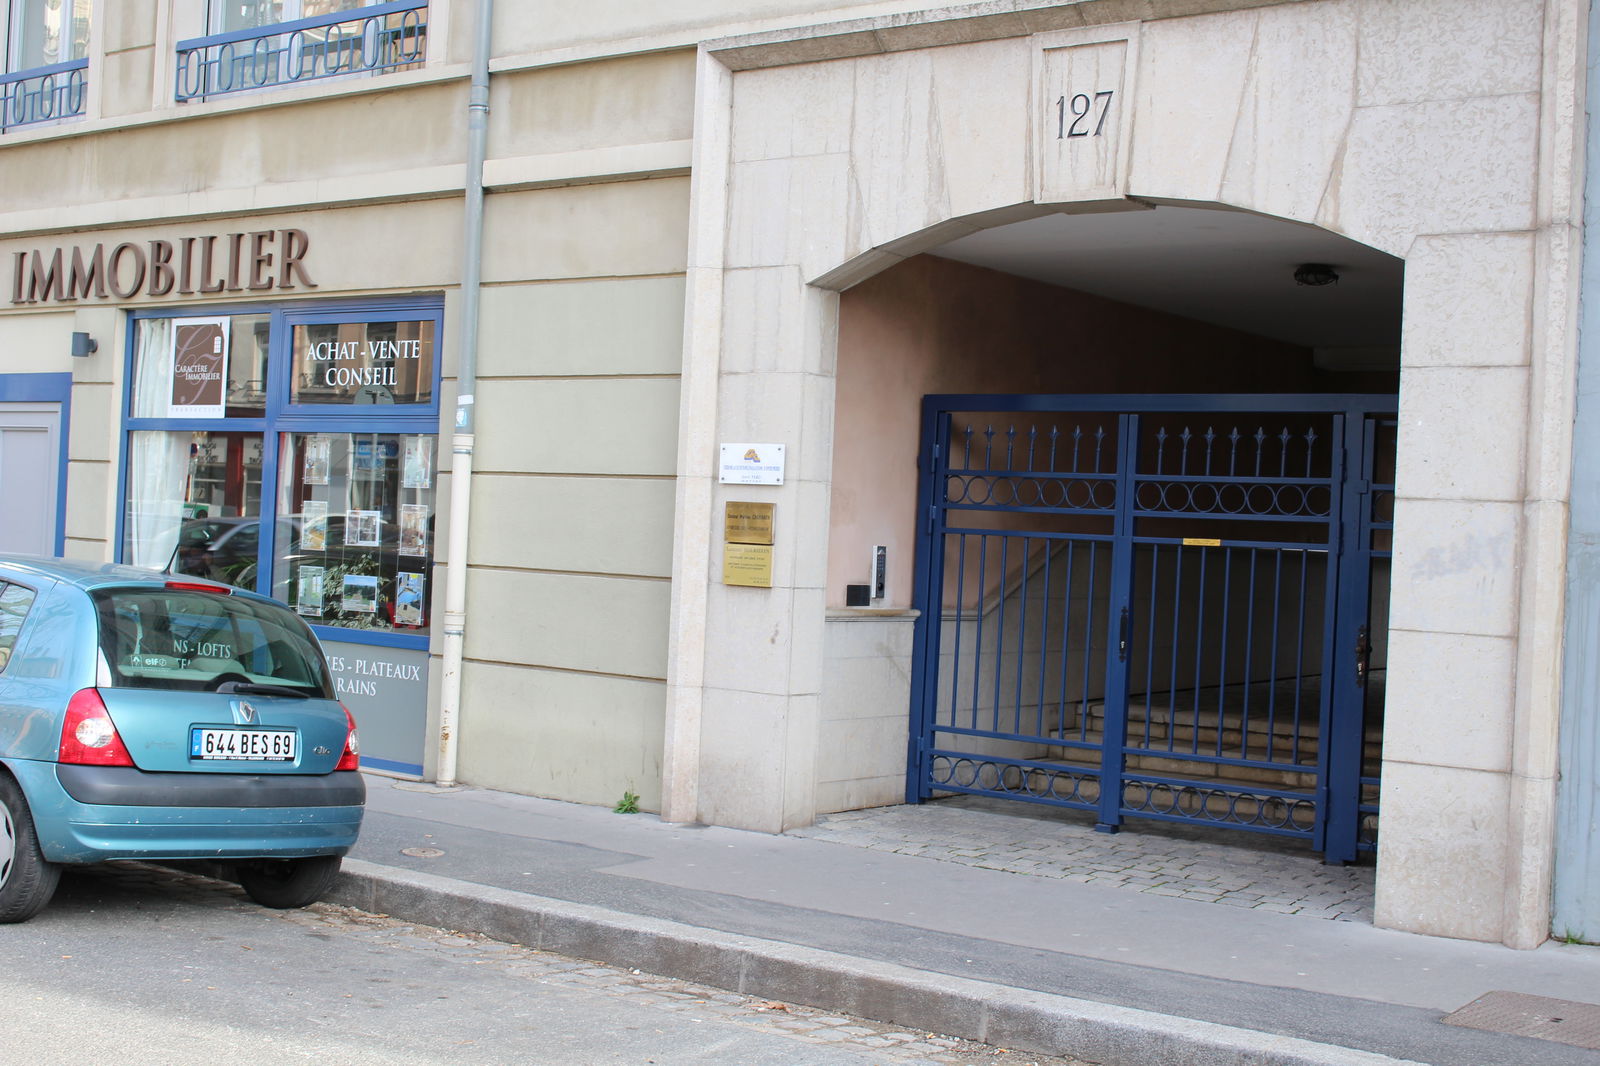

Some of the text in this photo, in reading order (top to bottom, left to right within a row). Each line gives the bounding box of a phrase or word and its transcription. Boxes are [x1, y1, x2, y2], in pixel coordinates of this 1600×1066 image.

[1056, 90, 1114, 140] 127
[11, 228, 318, 304] IMMOBILIER
[306, 341, 359, 361] ACHAT
[367, 339, 421, 360] VENTE
[325, 366, 398, 386] CONSEIL
[197, 642, 232, 659] LOFTS
[355, 659, 420, 681] PLATEAUX
[206, 732, 291, 755] 644 BES 69
